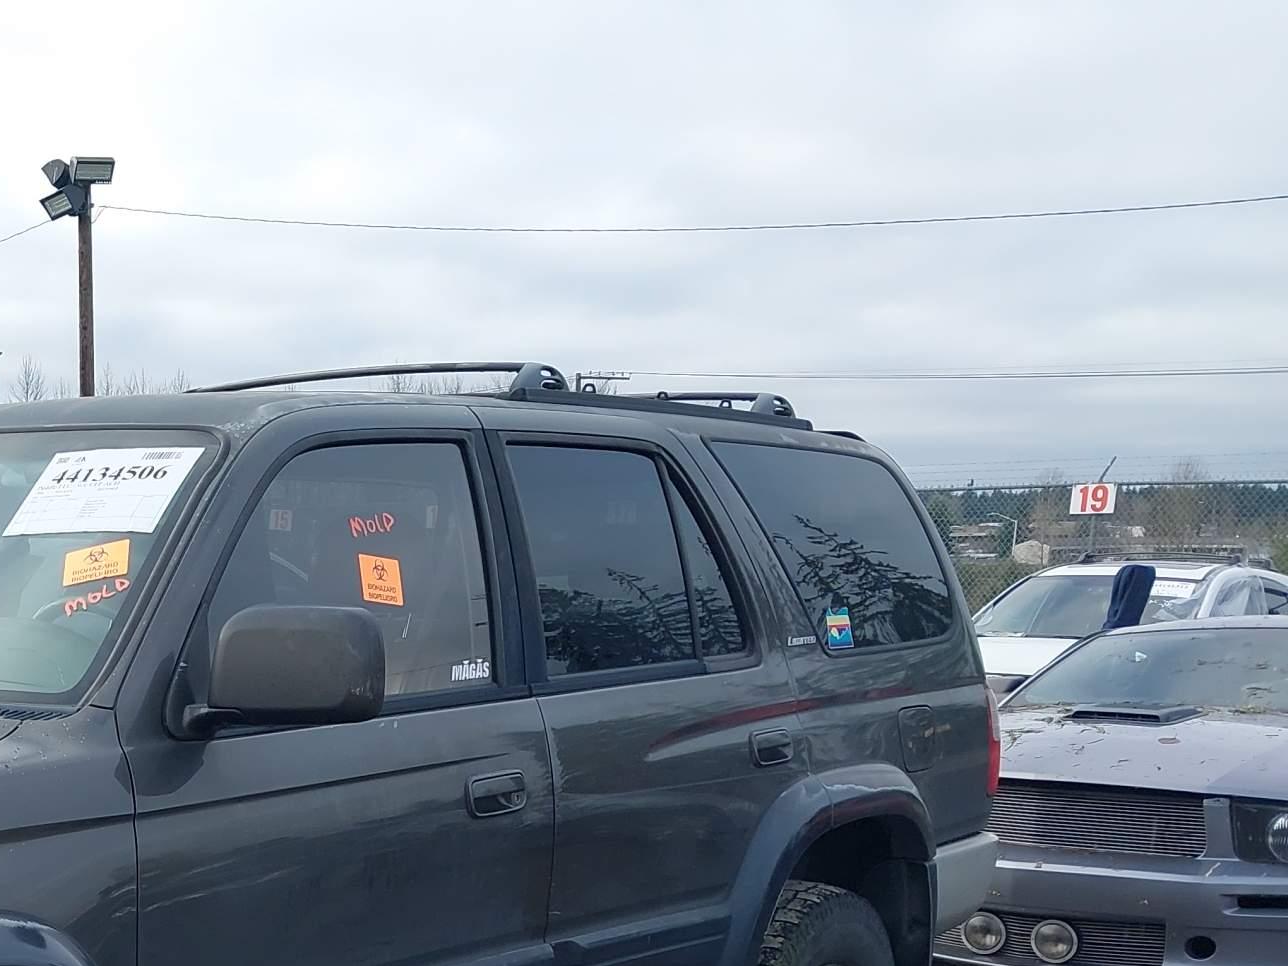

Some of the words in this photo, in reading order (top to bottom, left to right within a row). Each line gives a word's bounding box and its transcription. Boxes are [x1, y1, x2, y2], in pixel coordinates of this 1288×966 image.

[51, 465, 170, 484] 44134506
[1079, 485, 1109, 513] 19
[72, 561, 119, 577] BIOHAZARD
[64, 578, 130, 617] MOLD
[367, 583, 397, 593] BIOHAZARD
